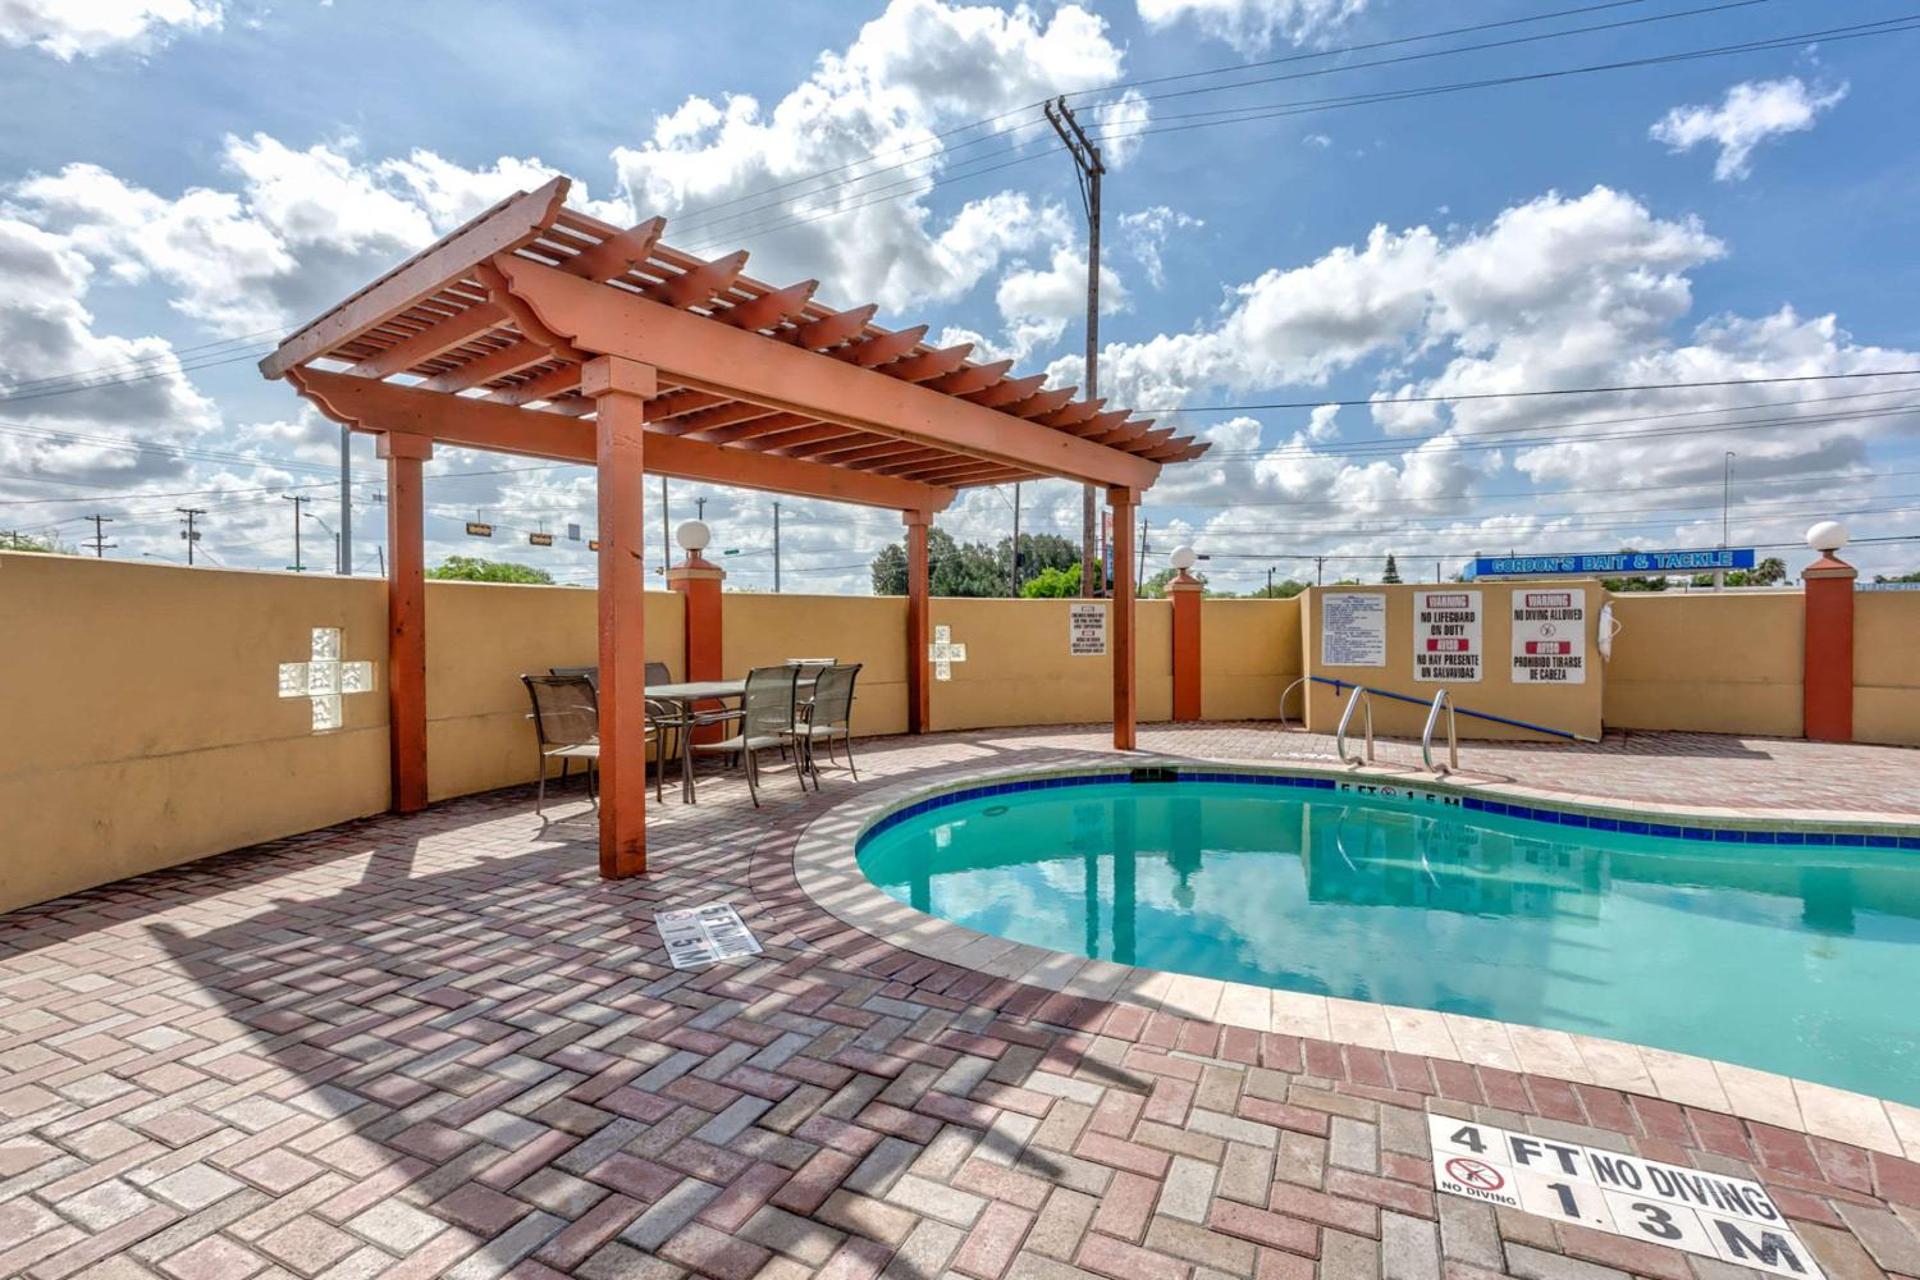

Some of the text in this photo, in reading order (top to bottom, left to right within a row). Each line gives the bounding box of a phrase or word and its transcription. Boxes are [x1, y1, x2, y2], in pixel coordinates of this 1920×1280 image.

[1492, 551, 1733, 573] GORDON'S BAIT & TACKLE
[1429, 596, 1465, 607] WARNING
[1528, 595, 1568, 607] WARNING
[1421, 612, 1475, 622] NO LIFEGUARD
[1514, 609, 1582, 620] NO DIVING ALLOWED
[1431, 625, 1464, 635] ON DUTY
[1437, 639, 1458, 651] AVISO
[1536, 642, 1560, 654] AVISO
[1417, 654, 1478, 665] NO HAY PRESENTE
[1514, 656, 1582, 667] PROHIBIDO TIRARSE
[1421, 667, 1475, 678] UN SALVAVIDAS
[1530, 669, 1567, 680] DE CABEZA
[676, 949, 713, 966] M
[1450, 1126, 1778, 1221] 4 FT NO DIVING
[1442, 1181, 1517, 1206] NO DIVING
[1714, 1219, 1808, 1275] M
